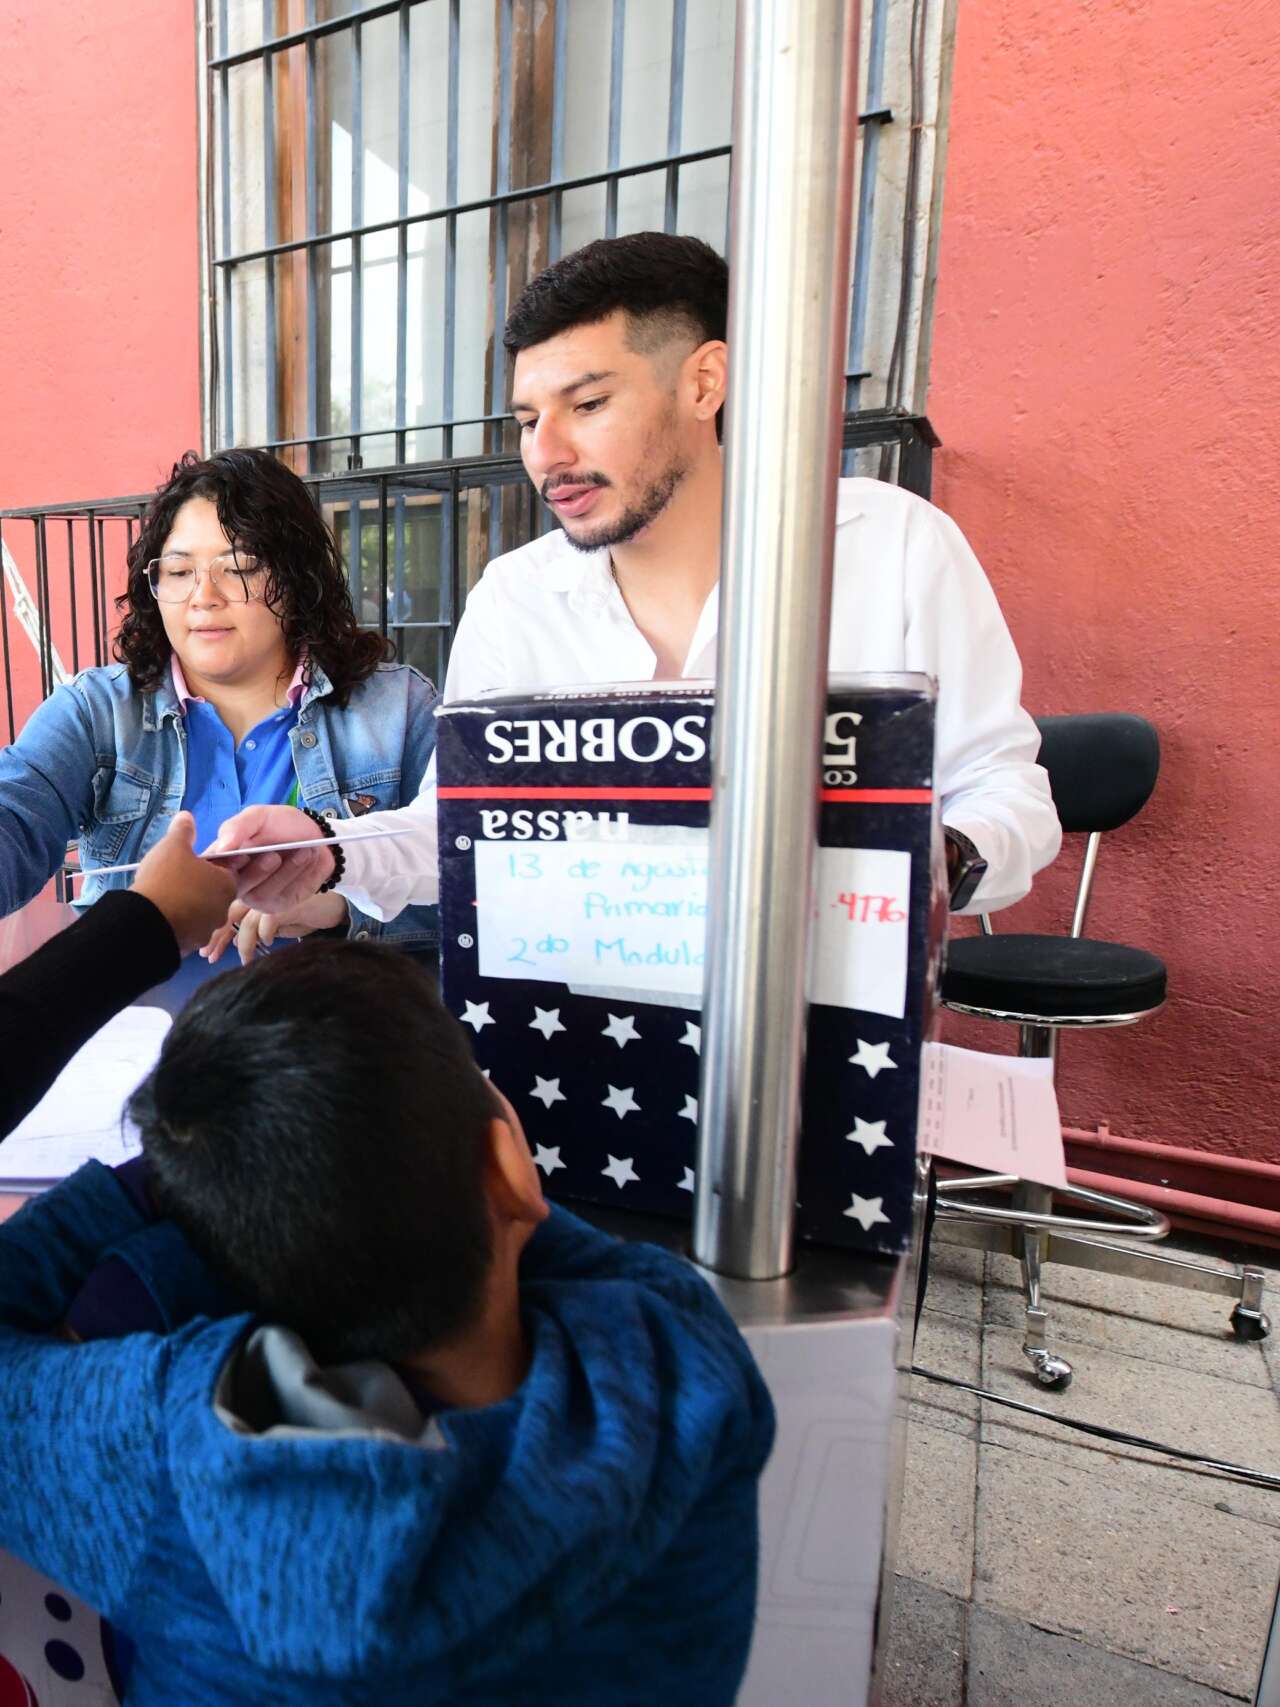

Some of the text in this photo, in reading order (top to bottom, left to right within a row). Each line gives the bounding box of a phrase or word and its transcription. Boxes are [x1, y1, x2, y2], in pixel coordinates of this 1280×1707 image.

[483, 715, 707, 764] SOBRES
[479, 809, 630, 842] nassa
[508, 852, 544, 880] 13
